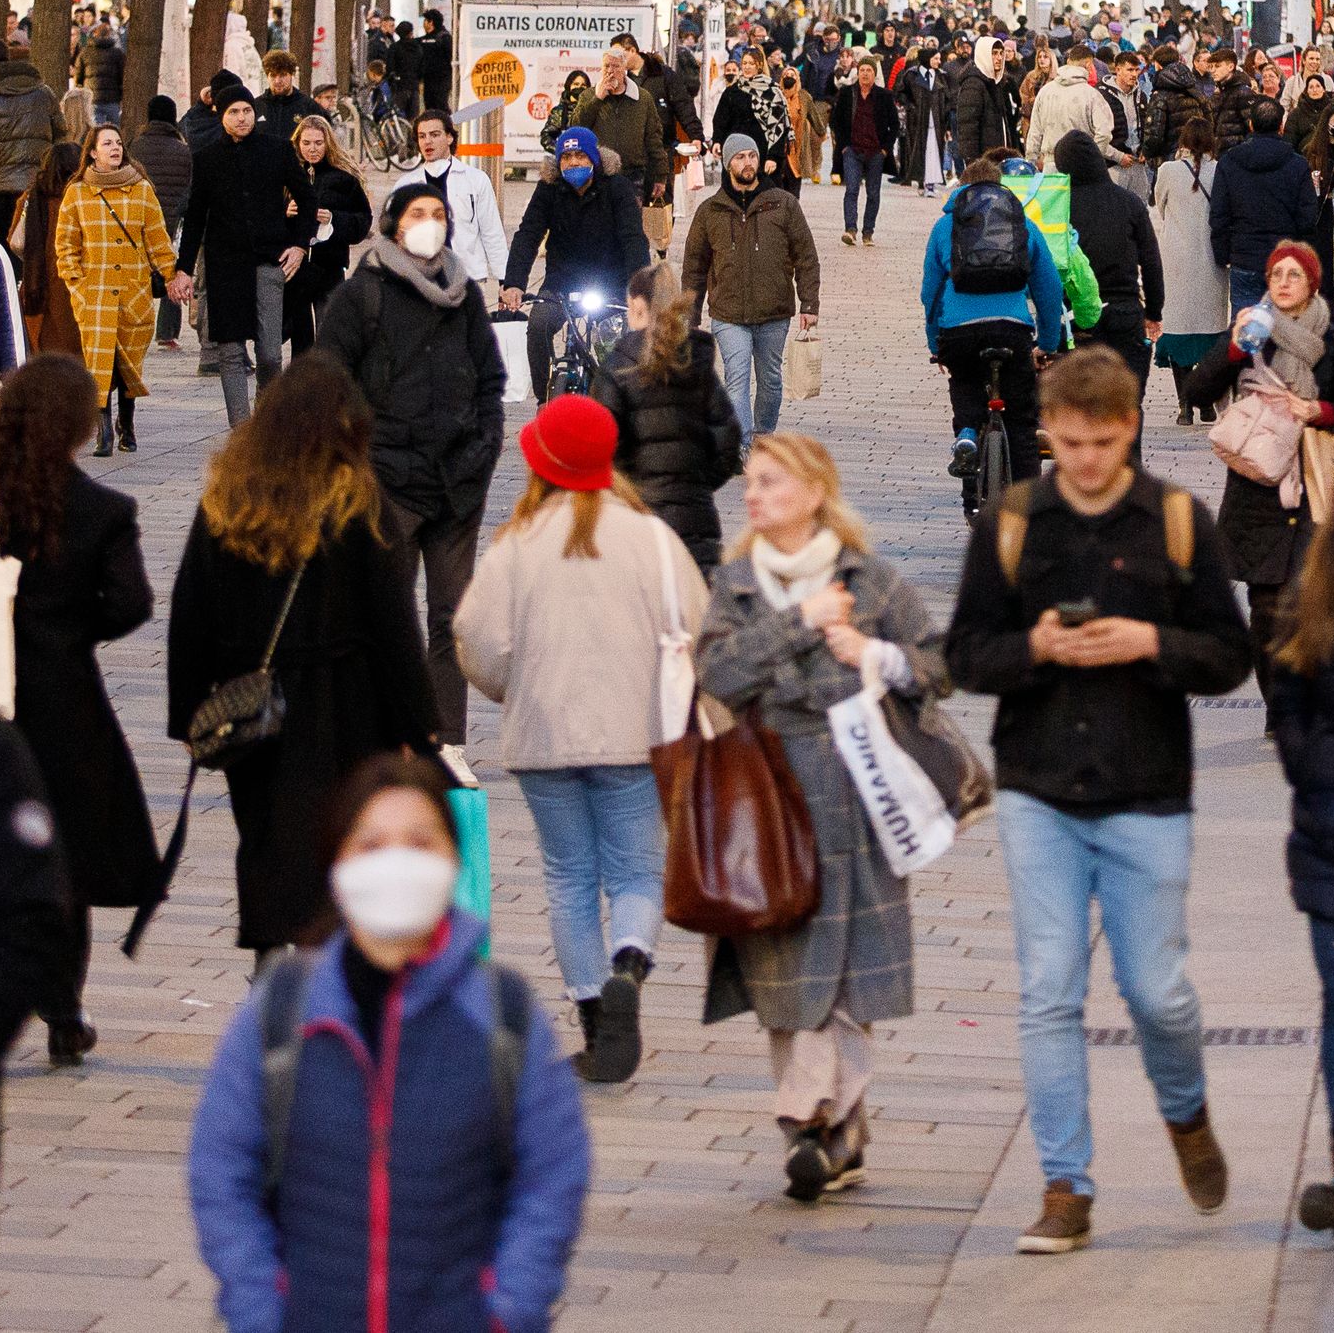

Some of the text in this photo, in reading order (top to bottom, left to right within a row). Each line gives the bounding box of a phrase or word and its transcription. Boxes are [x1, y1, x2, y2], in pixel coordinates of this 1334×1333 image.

[476, 15, 635, 33] GRATIS CORONATEST
[504, 38, 604, 50] ANTIGEN SCHNELLTEST
[475, 60, 518, 74] SOFORT
[481, 73, 513, 85] OHNE
[476, 84, 519, 97] TERMIN
